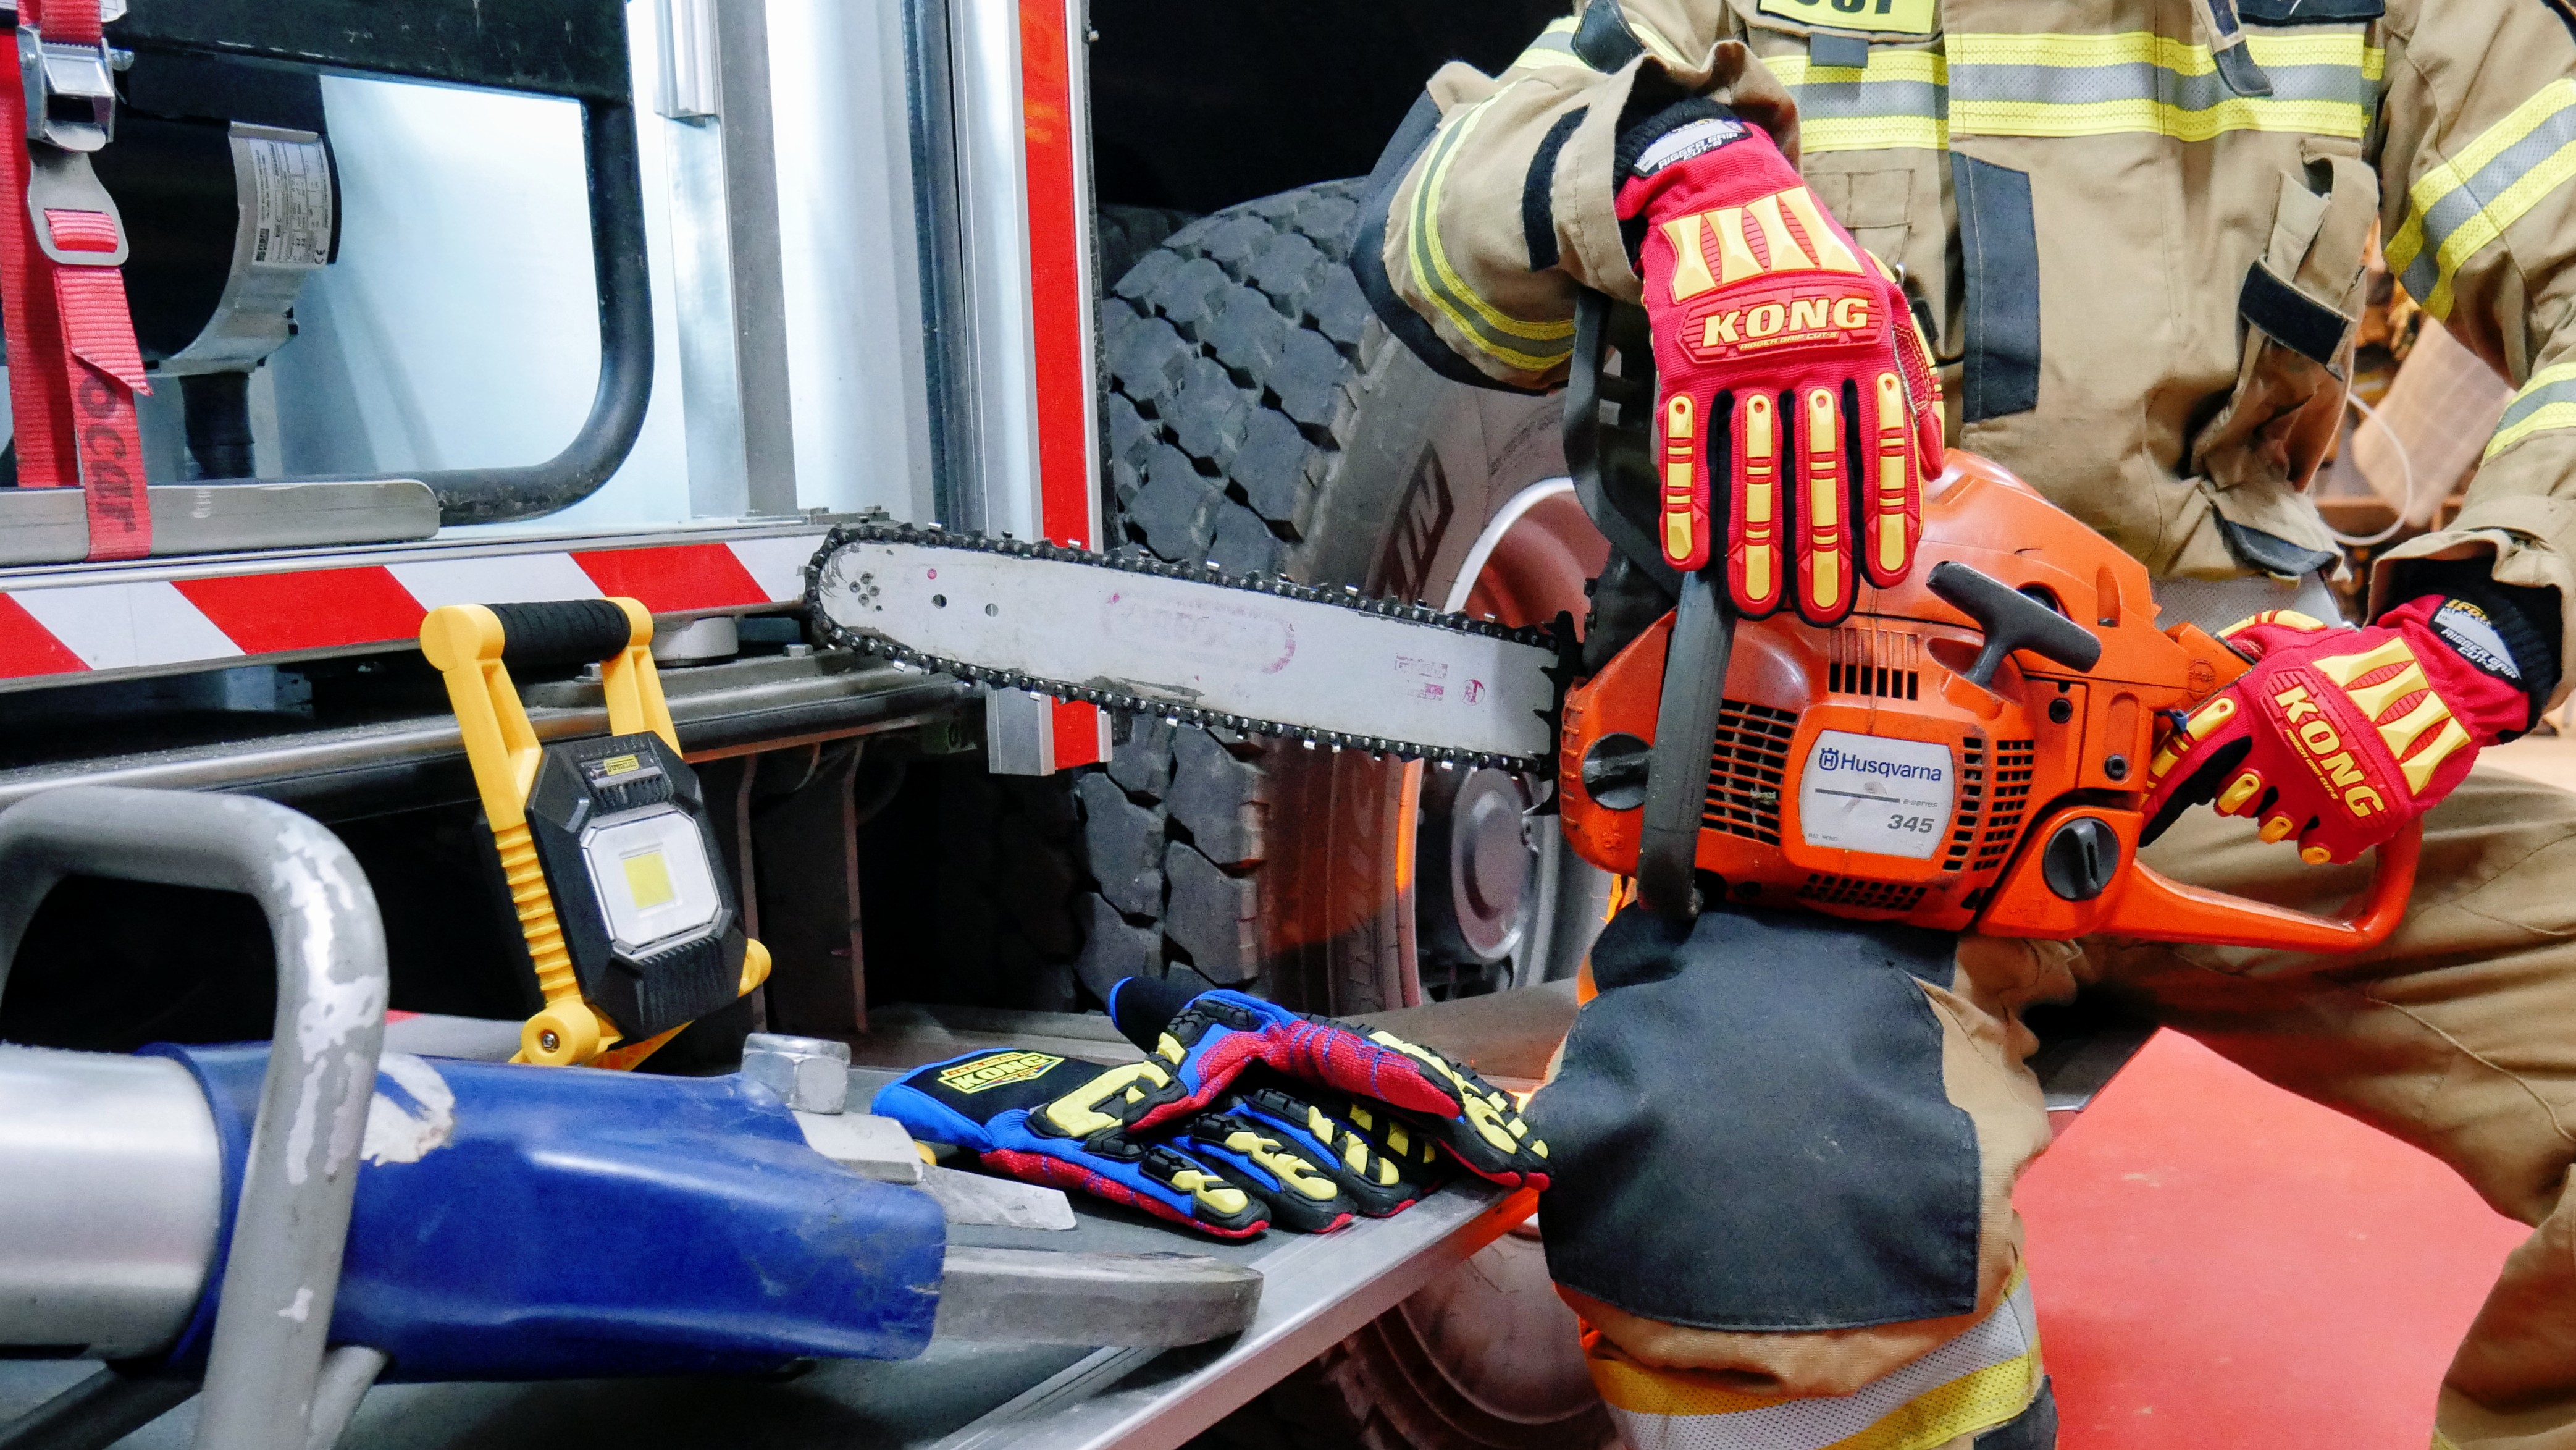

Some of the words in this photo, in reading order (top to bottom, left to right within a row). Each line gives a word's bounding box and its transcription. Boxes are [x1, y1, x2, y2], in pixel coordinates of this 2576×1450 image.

[1703, 298, 1869, 347] KONG
[1740, 338, 1778, 350] RIGGER
[1779, 335, 1804, 344] GRIP
[2275, 686, 2385, 817] KONG
[2285, 729, 2309, 759] RIGGER
[1840, 752, 1942, 782] Husqvarna
[1887, 814, 1935, 833] 345
[951, 1055, 1050, 1089] KONG
